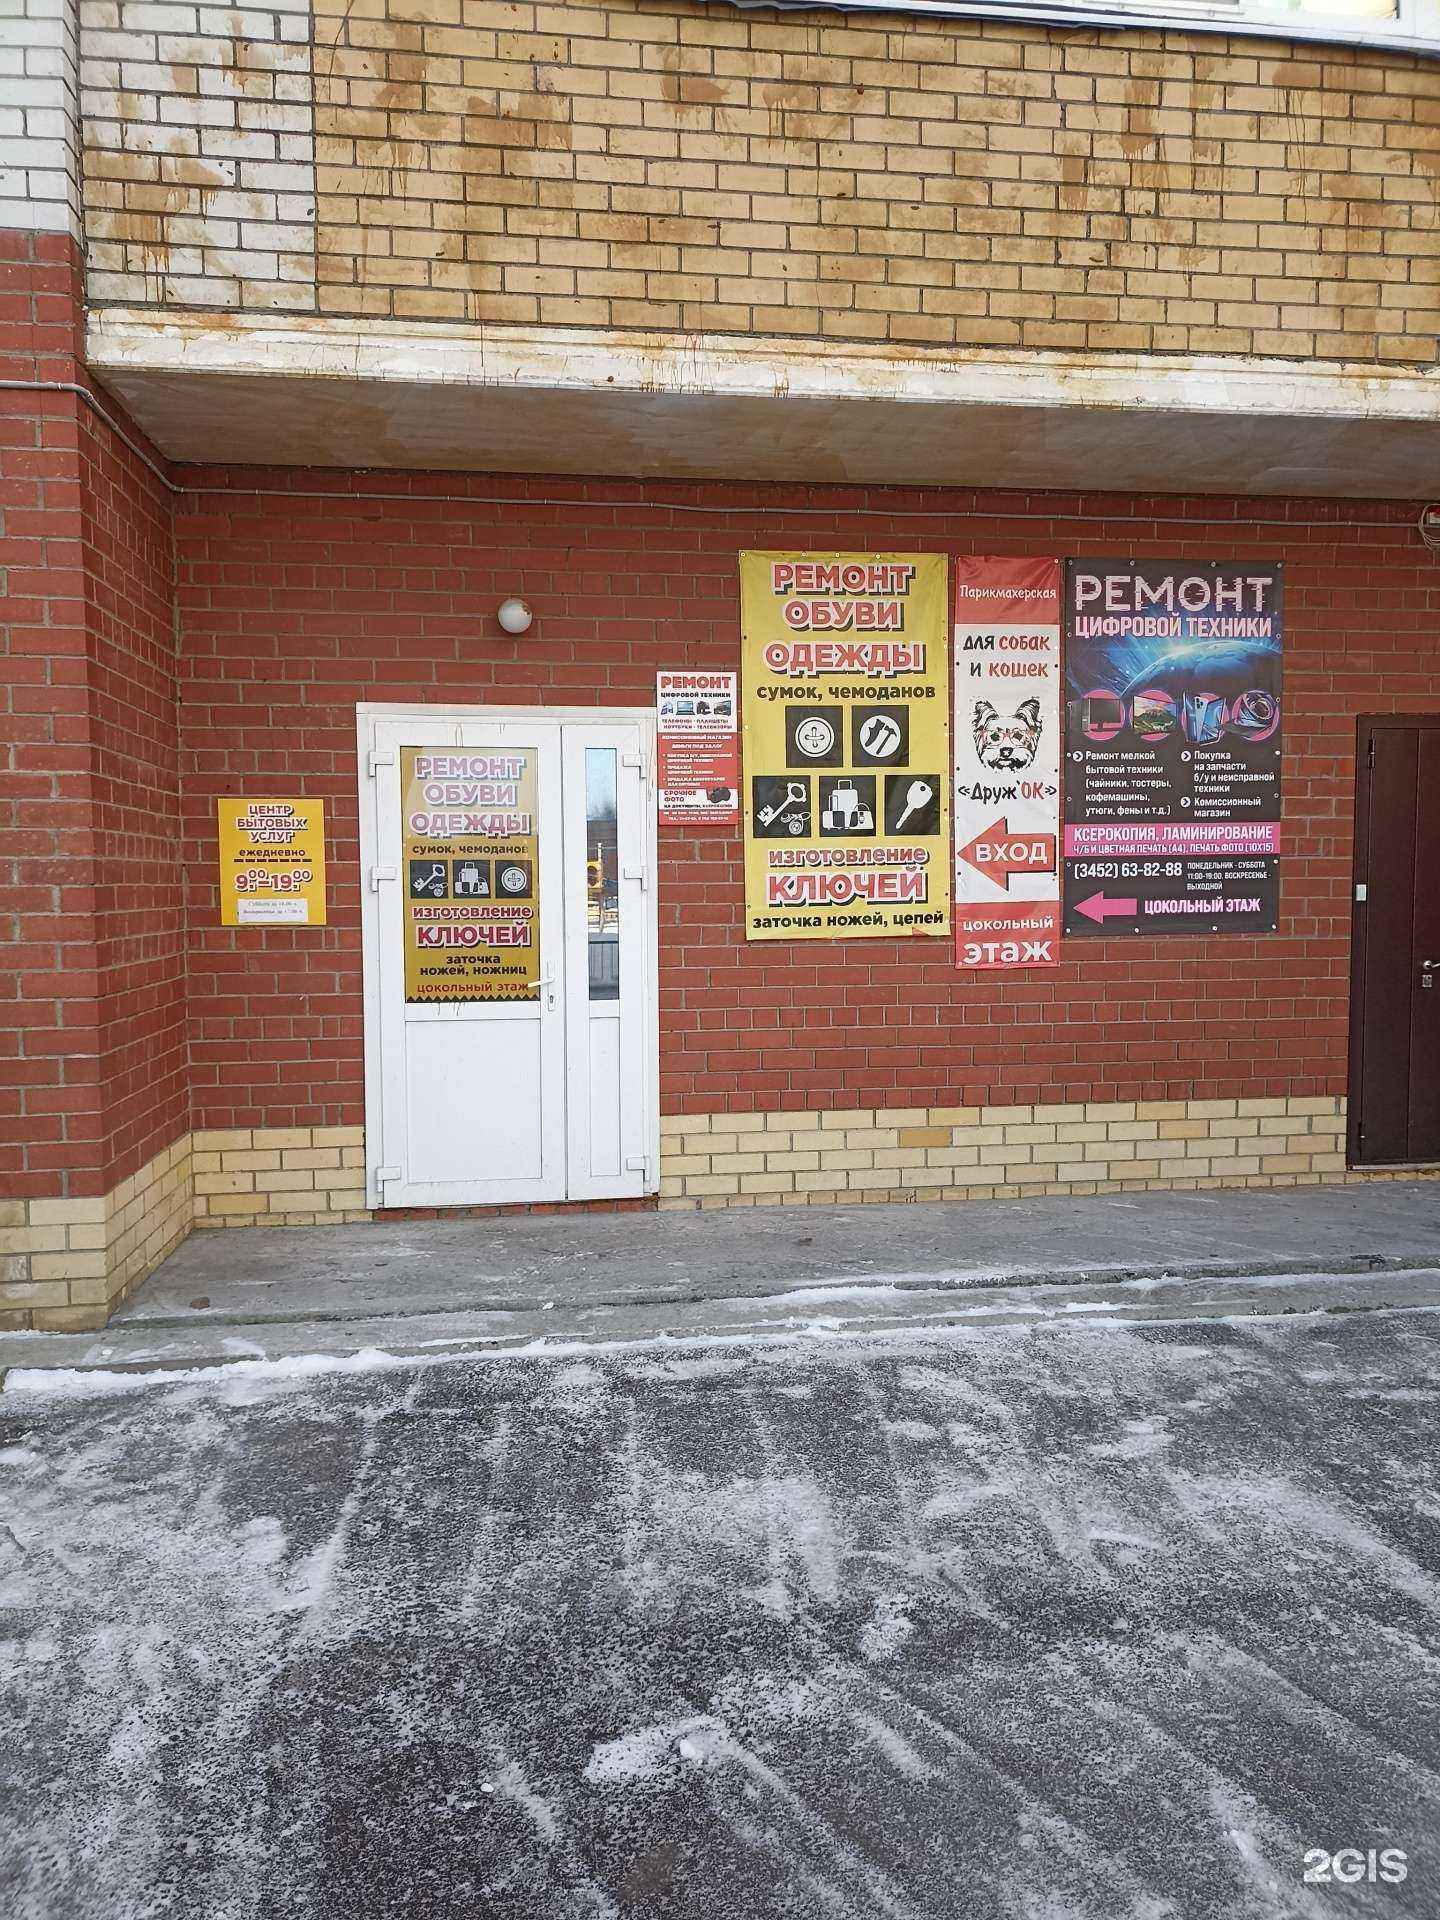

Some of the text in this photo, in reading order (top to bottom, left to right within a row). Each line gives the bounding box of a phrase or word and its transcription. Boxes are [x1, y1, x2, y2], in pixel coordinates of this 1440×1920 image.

[772, 562, 915, 594] РЕМОНТ
[959, 585, 1057, 601] Парикмахерская
[1075, 575, 1273, 612] РЕМОНТ
[783, 599, 904, 630] ОБУВИ
[1075, 612, 1273, 638] ЦИФРОВОЙ ТЕХНИКИ
[764, 642, 926, 677] ОДЕЖДЫ
[661, 676, 731, 688] РЕМОНТ
[757, 685, 936, 701] сумок, чемоданов
[1085, 751, 1156, 760] Ремонт мелкой
[1194, 751, 1231, 761] Покупка
[415, 757, 526, 779] РЕМОНТ
[1085, 765, 1164, 774] бытовой техники
[1194, 763, 1247, 771] на запчасти
[1194, 773, 1210, 783] б/у
[1218, 771, 1275, 782] неисправной
[423, 782, 518, 806] ОБУВИ
[1194, 785, 1231, 793] техники
[1085, 792, 1151, 802] кофемашины,
[1194, 797, 1262, 806] Комиссионный
[249, 804, 294, 817] ЦЕНТР
[1117, 806, 1143, 816] фены
[1194, 809, 1231, 817] магазин
[237, 818, 307, 830] БЫТОВЫХ
[410, 812, 532, 838] ОДЕЖДЫ
[250, 831, 295, 843] УСЛУГ
[1162, 826, 1273, 841] ЛАМИНИРОВАНИЕ
[239, 849, 306, 858] ежедневно
[412, 845, 456, 855] сумок,
[975, 843, 1048, 865] ВХОД
[1073, 844, 1089, 855] Ч/Б
[1091, 845, 1097, 853] И
[1098, 844, 1136, 854] ЦВЕТНАЯ
[1137, 844, 1167, 853] ПЕЧАТЬ
[1190, 844, 1220, 852] ПЕЧАТЬ
[1221, 843, 1244, 852] ФОТО
[769, 848, 929, 865] изготовление
[1074, 862, 1182, 879] (3452) 63-82-88
[1187, 862, 1234, 870] ПОНЕДЕЛЬНИК
[1238, 861, 1266, 869] СУББОТА
[1224, 871, 1268, 879] ВОСКРЕСЕНЬЕ
[768, 866, 929, 905] КЛЮЧЕЙ
[1187, 881, 1223, 890] ВЫХОДНОЙ
[1144, 896, 1261, 914] ЦОКОЛЬНЫЙ ЭТАЖ
[412, 905, 533, 919] изготовление
[752, 911, 944, 928] заточка ножей, цепей
[963, 916, 1054, 933] цокольный
[415, 922, 532, 947] КЛЮЧЕЙ
[963, 941, 1053, 964] этаж
[446, 955, 501, 964] заточка
[420, 965, 527, 976] ножей, ножниц
[417, 982, 528, 993] цокольный этаж
